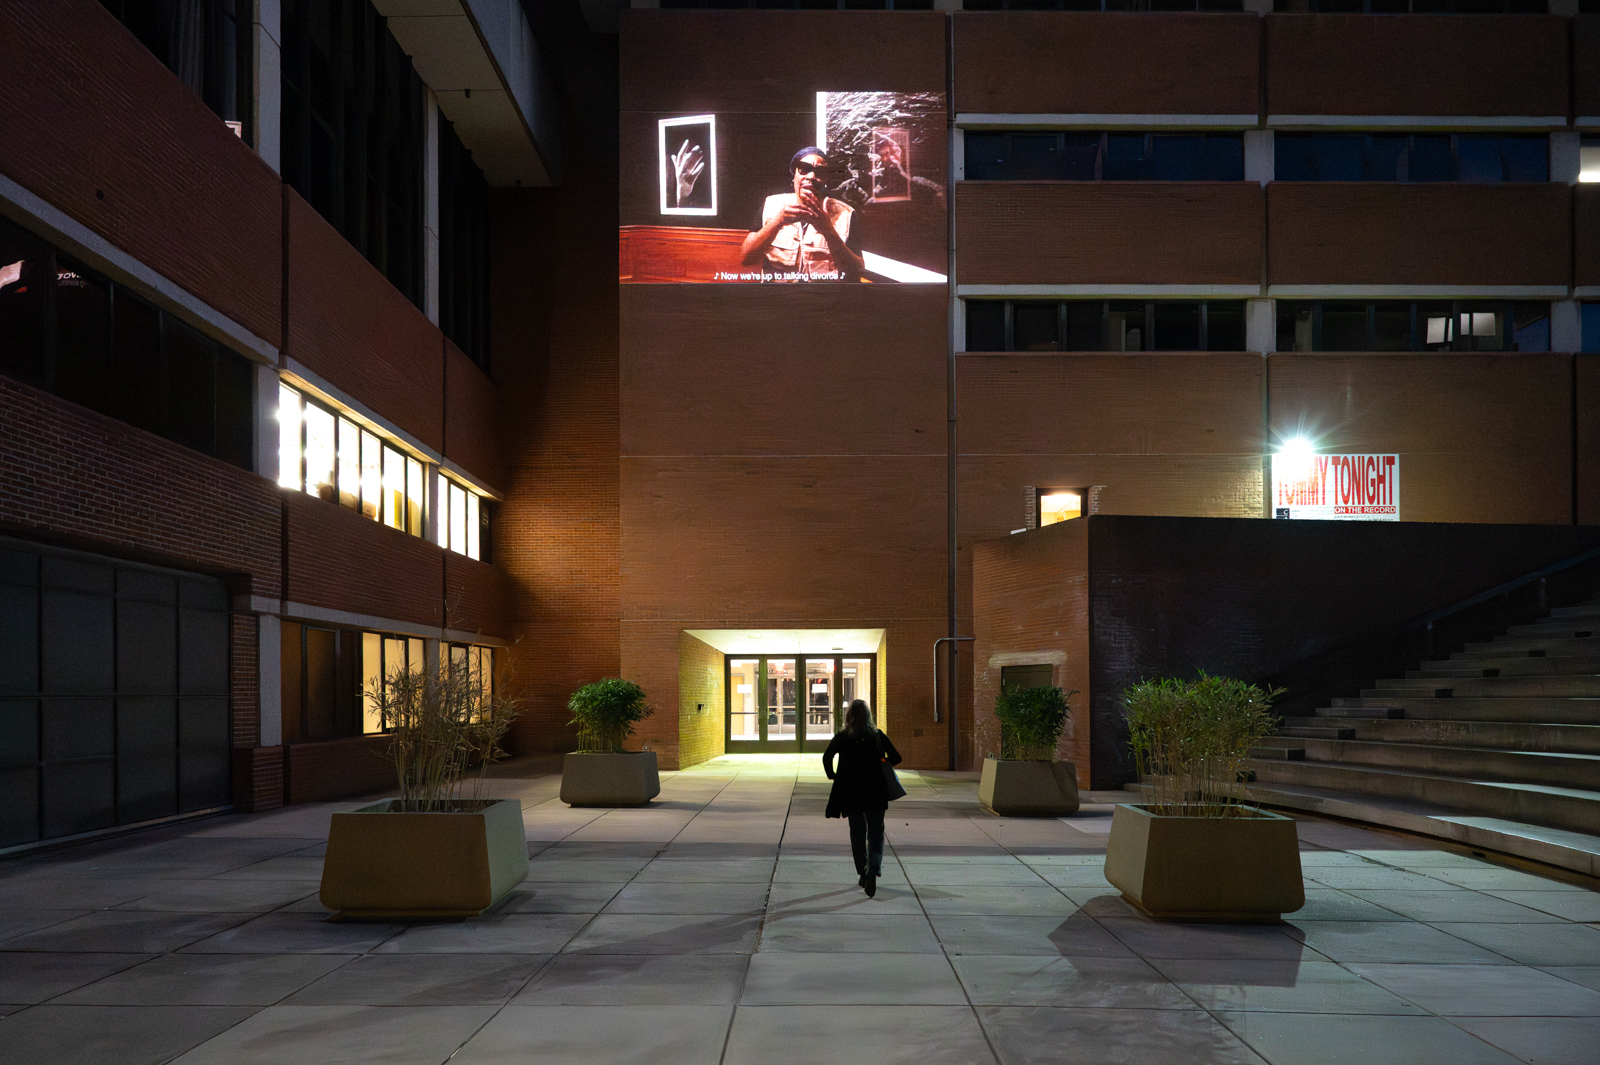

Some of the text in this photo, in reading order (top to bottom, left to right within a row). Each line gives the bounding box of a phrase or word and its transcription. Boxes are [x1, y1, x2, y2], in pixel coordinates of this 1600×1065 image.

[720, 272, 839, 282] Now we're up to talking divorce
[1331, 456, 1396, 505] TONIGHT
[1334, 506, 1396, 514] ON THE RECORD
